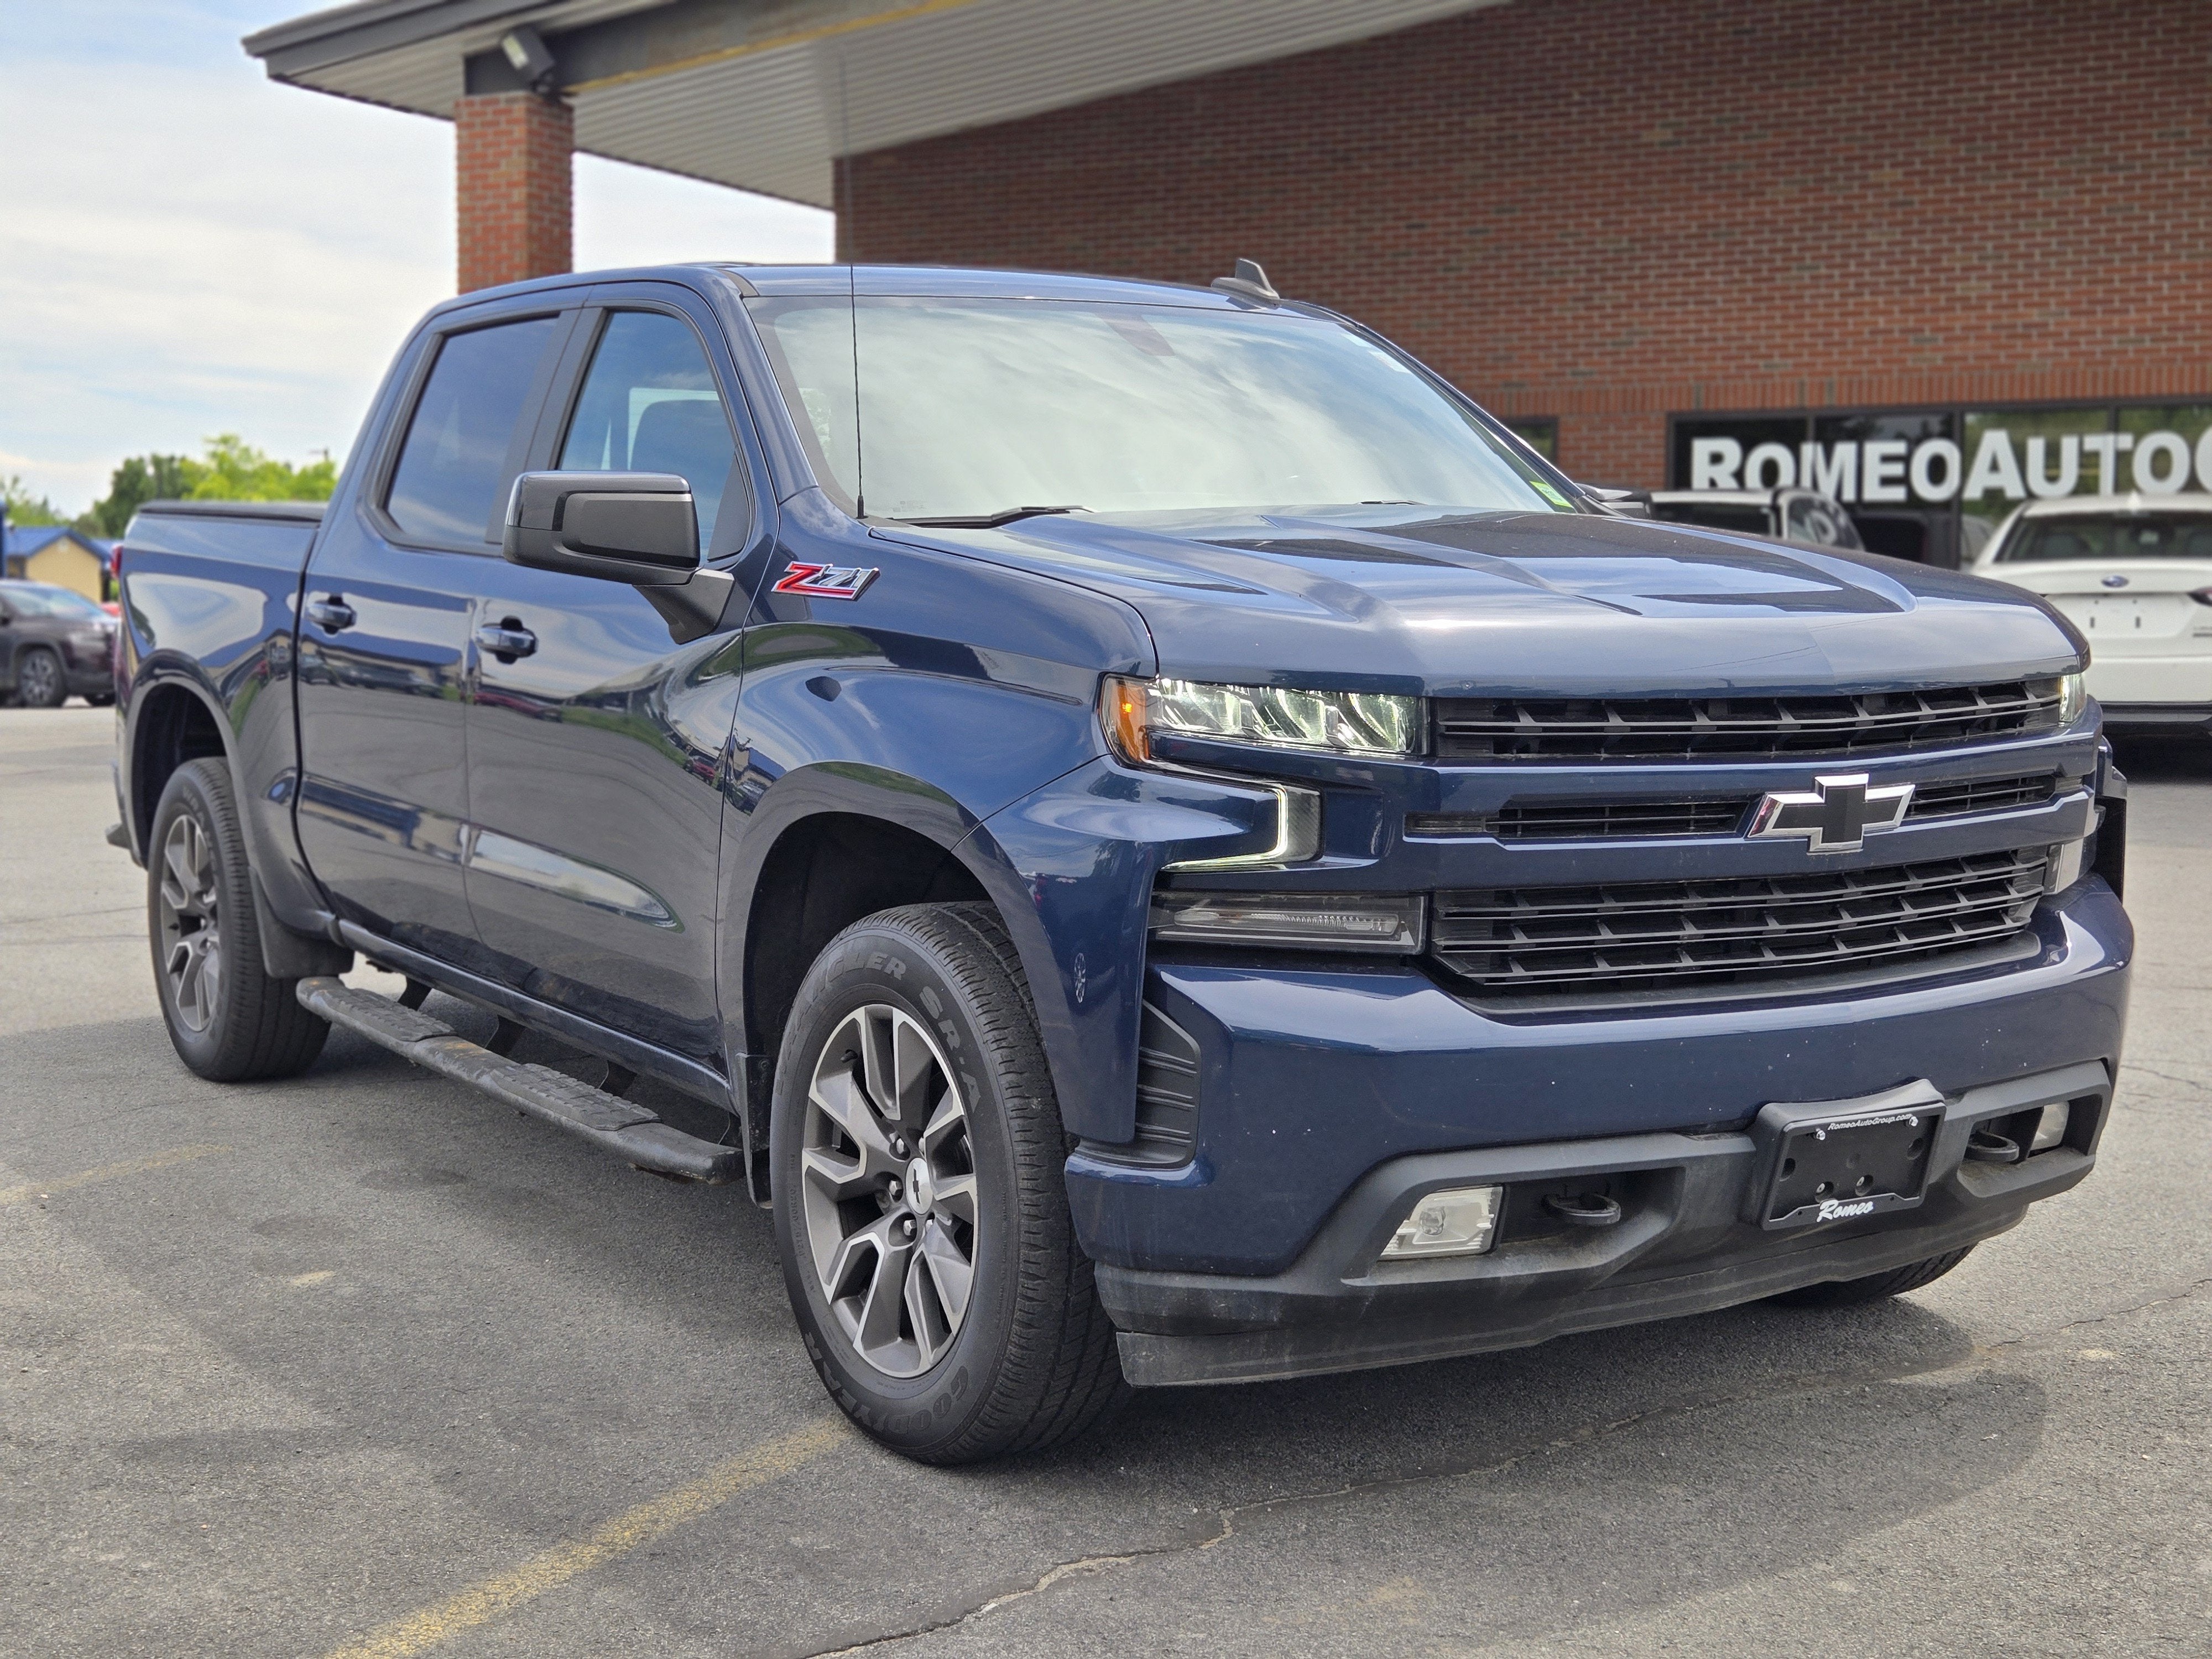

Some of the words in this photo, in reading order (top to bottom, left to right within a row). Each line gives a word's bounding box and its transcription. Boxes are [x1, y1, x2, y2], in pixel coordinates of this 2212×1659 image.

[1691, 426, 2212, 503] ROMEOAUTO
[771, 561, 881, 601] Z71
[1827, 1113, 1913, 1130] RomeoAutoGroup.com
[1816, 1199, 1874, 1223] Romeo
[805, 1332, 969, 1434] GOODYEAR
